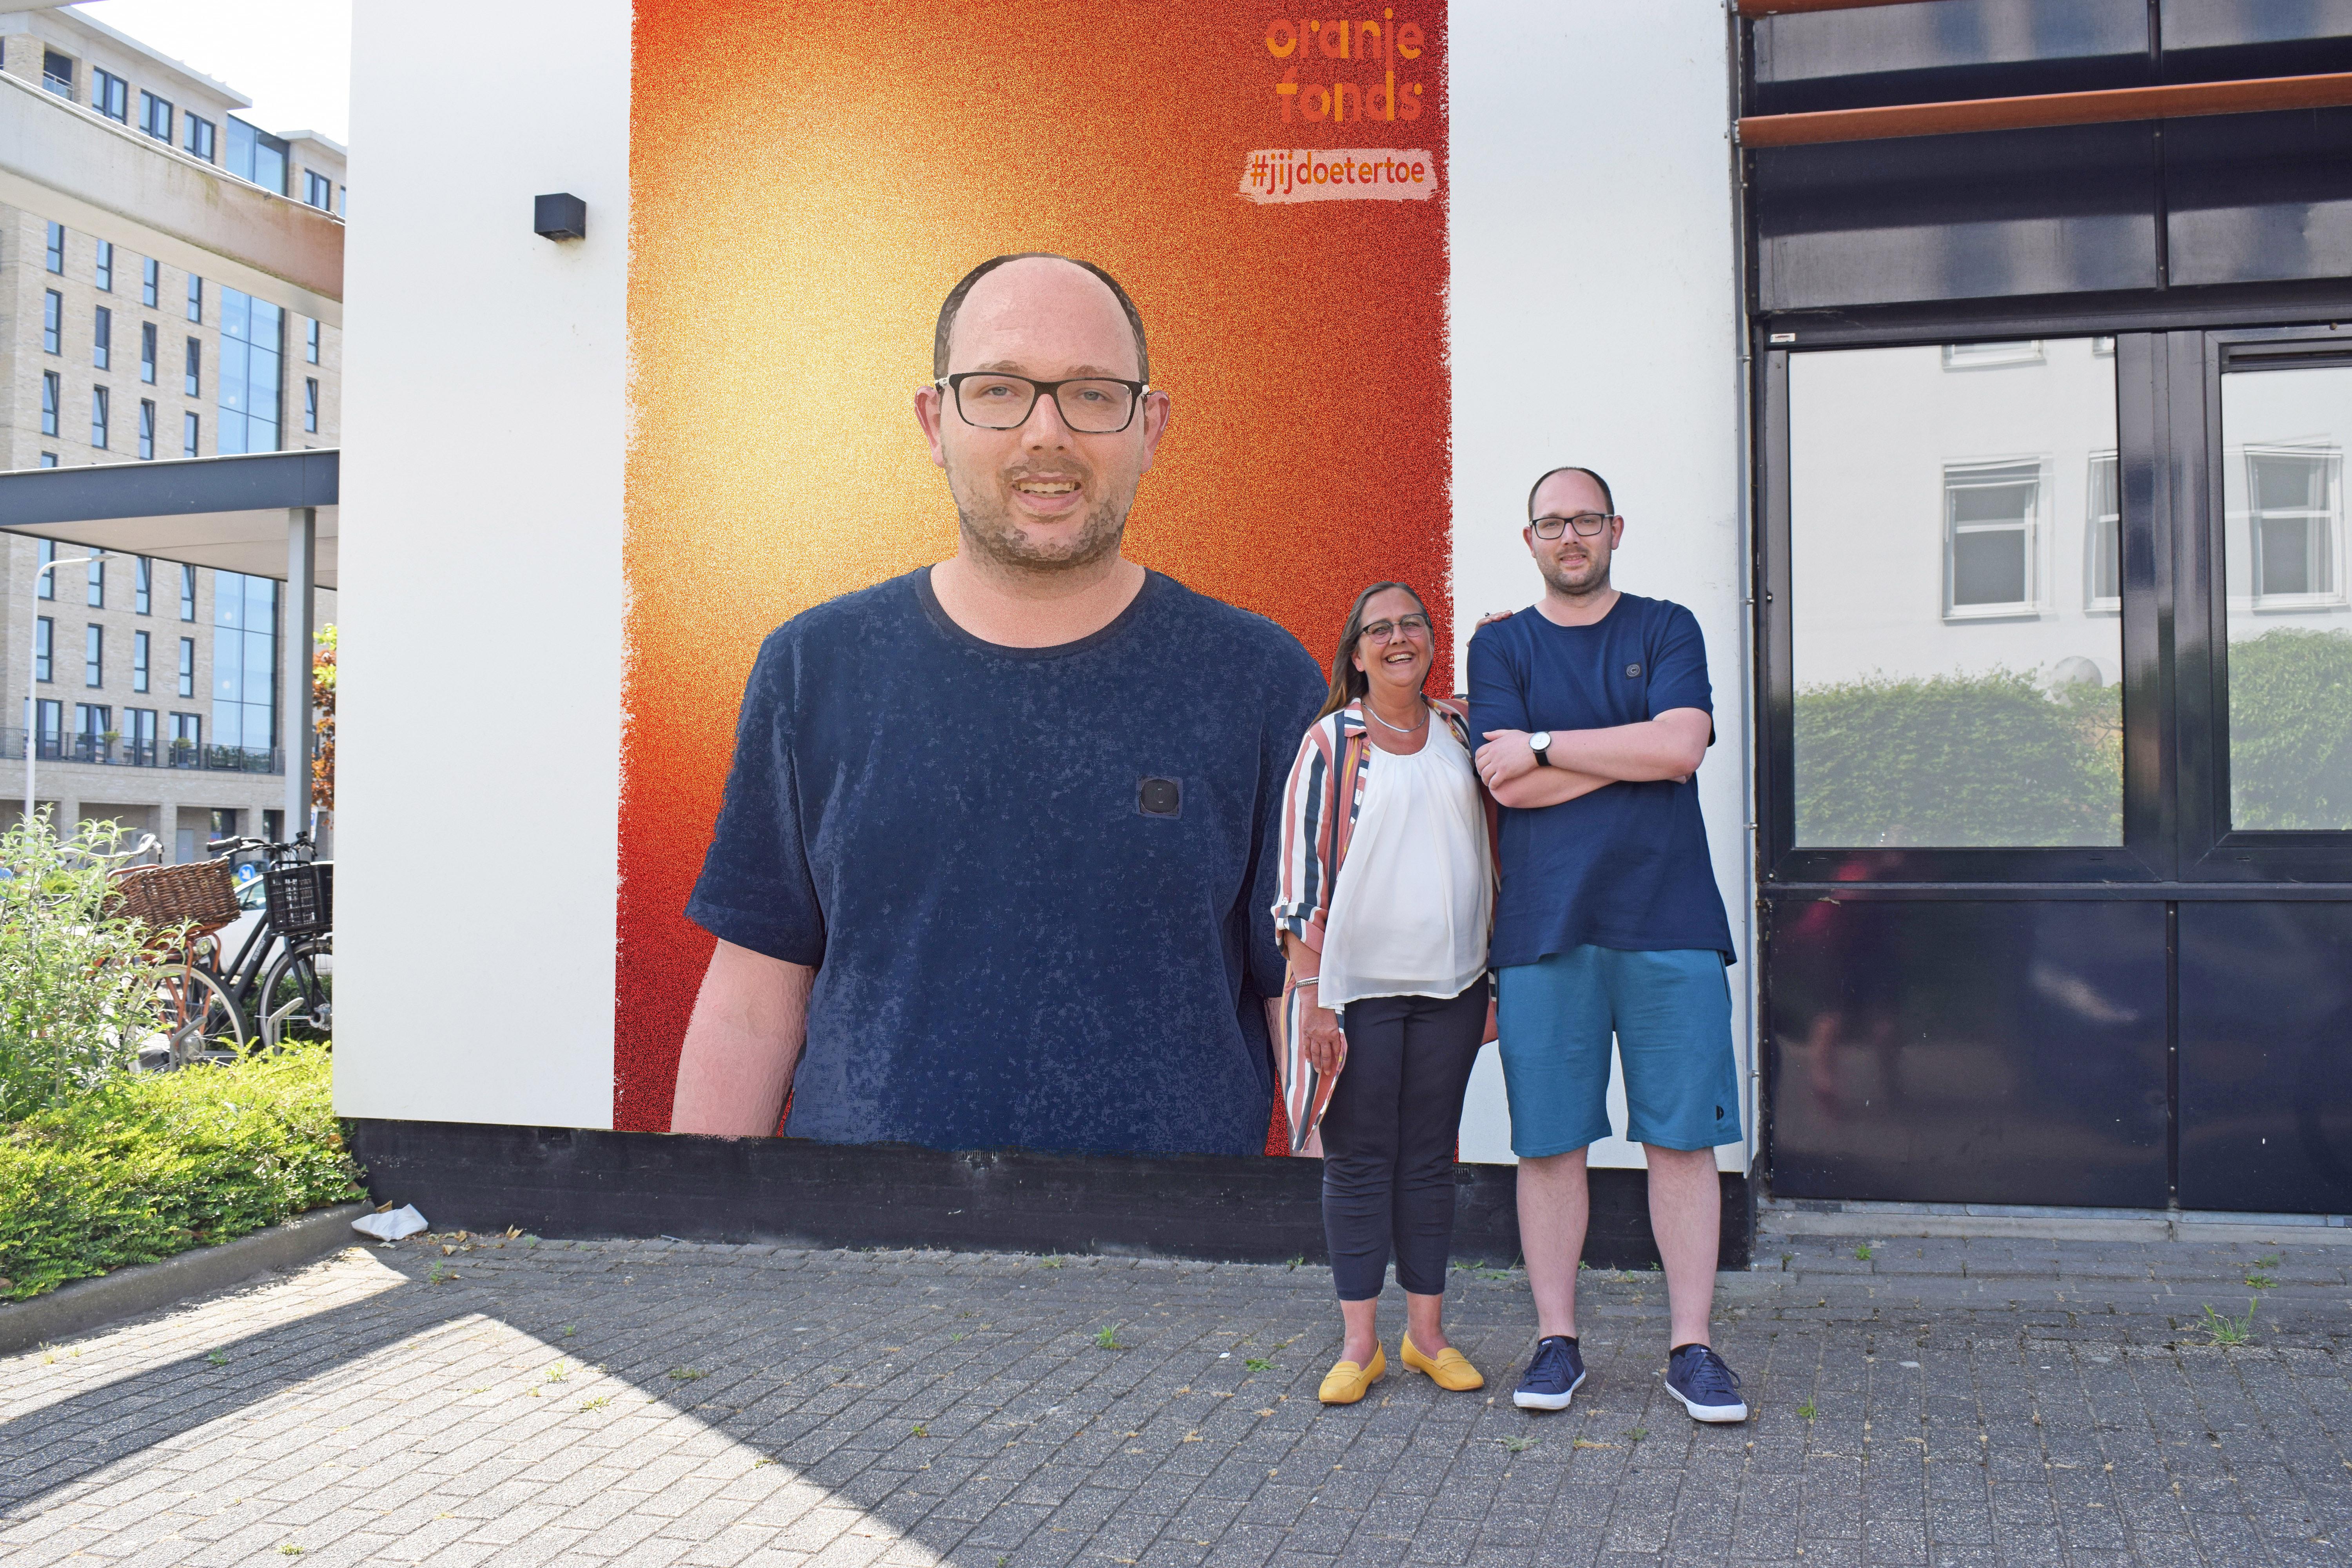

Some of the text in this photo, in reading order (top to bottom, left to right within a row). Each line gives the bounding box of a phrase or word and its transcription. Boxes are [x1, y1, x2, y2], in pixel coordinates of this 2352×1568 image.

[1266, 8, 1425, 71] oranje
[1276, 66, 1423, 123] fonds
[1250, 152, 1425, 195] #jijdoetertoe
